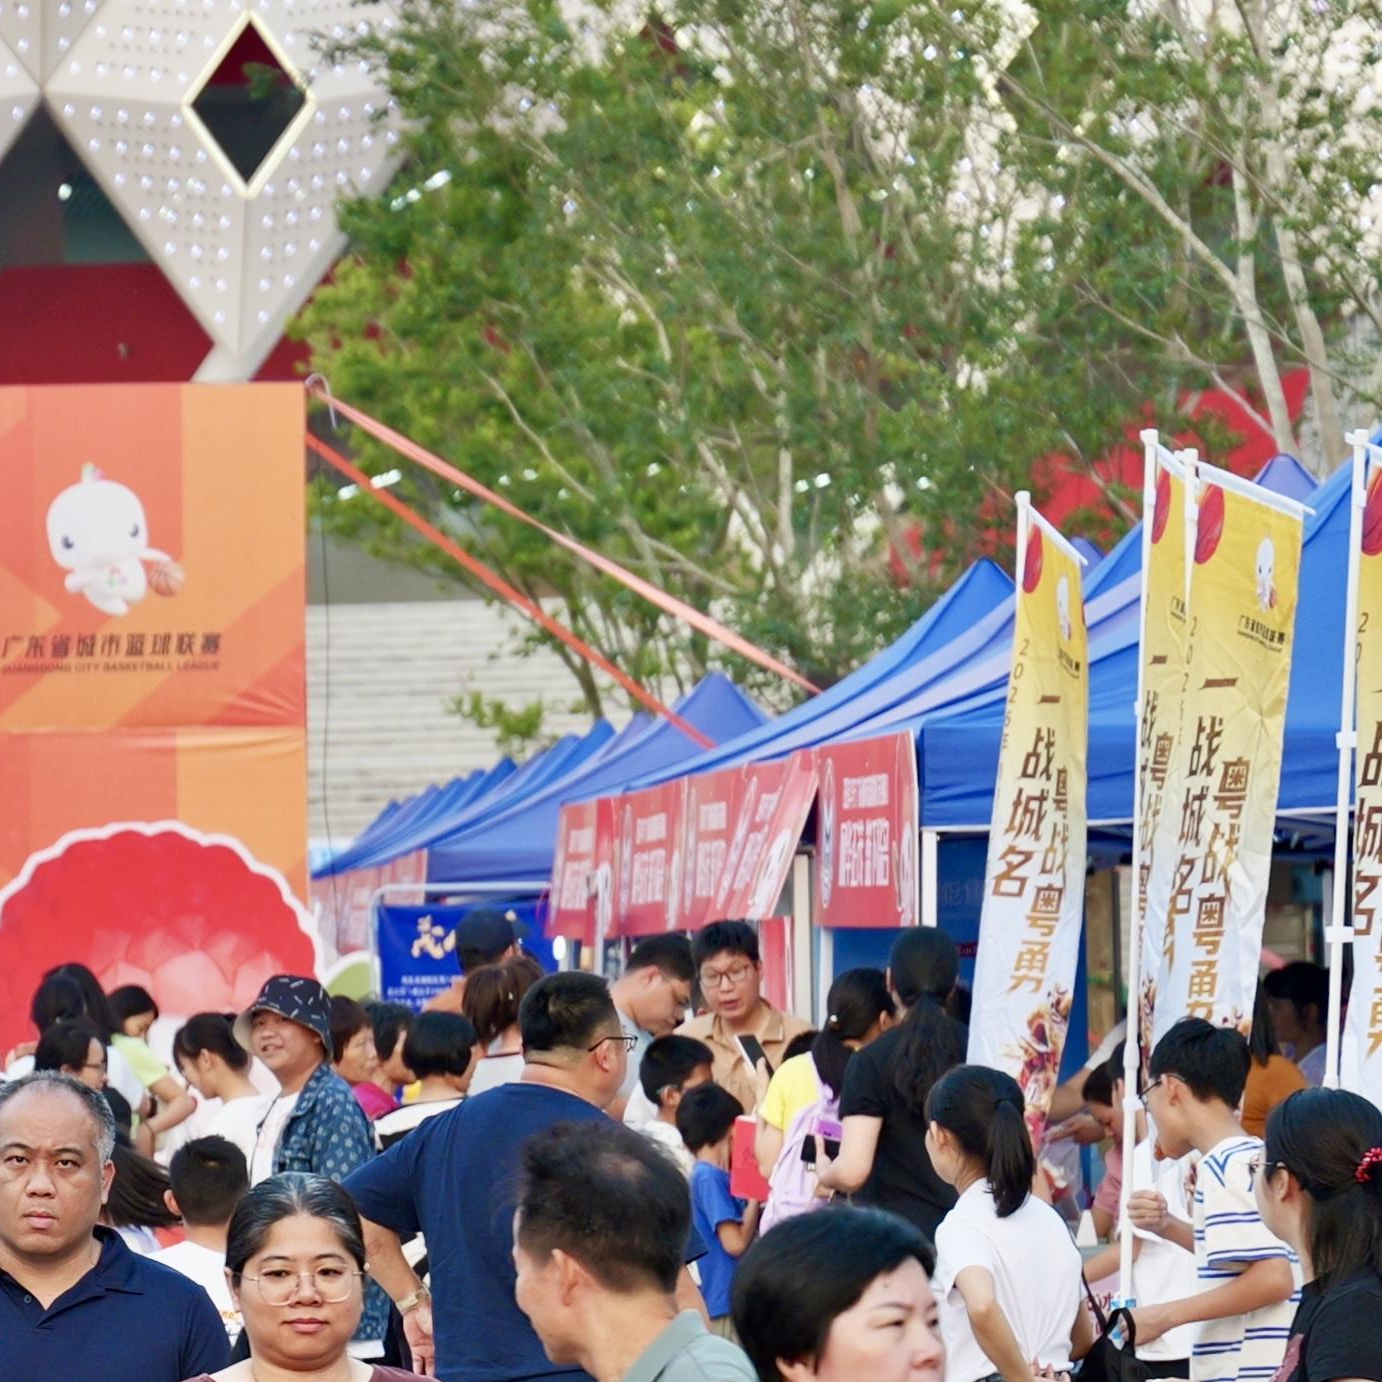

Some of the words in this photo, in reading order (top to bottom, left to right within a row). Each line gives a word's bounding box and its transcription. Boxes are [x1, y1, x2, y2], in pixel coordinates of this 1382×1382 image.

[1, 632, 221, 659] 广东省城市篮球联赛
[75, 661, 101, 672] CITY
[103, 661, 173, 672] BASKETBALL
[991, 695, 1061, 898] 一战城名
